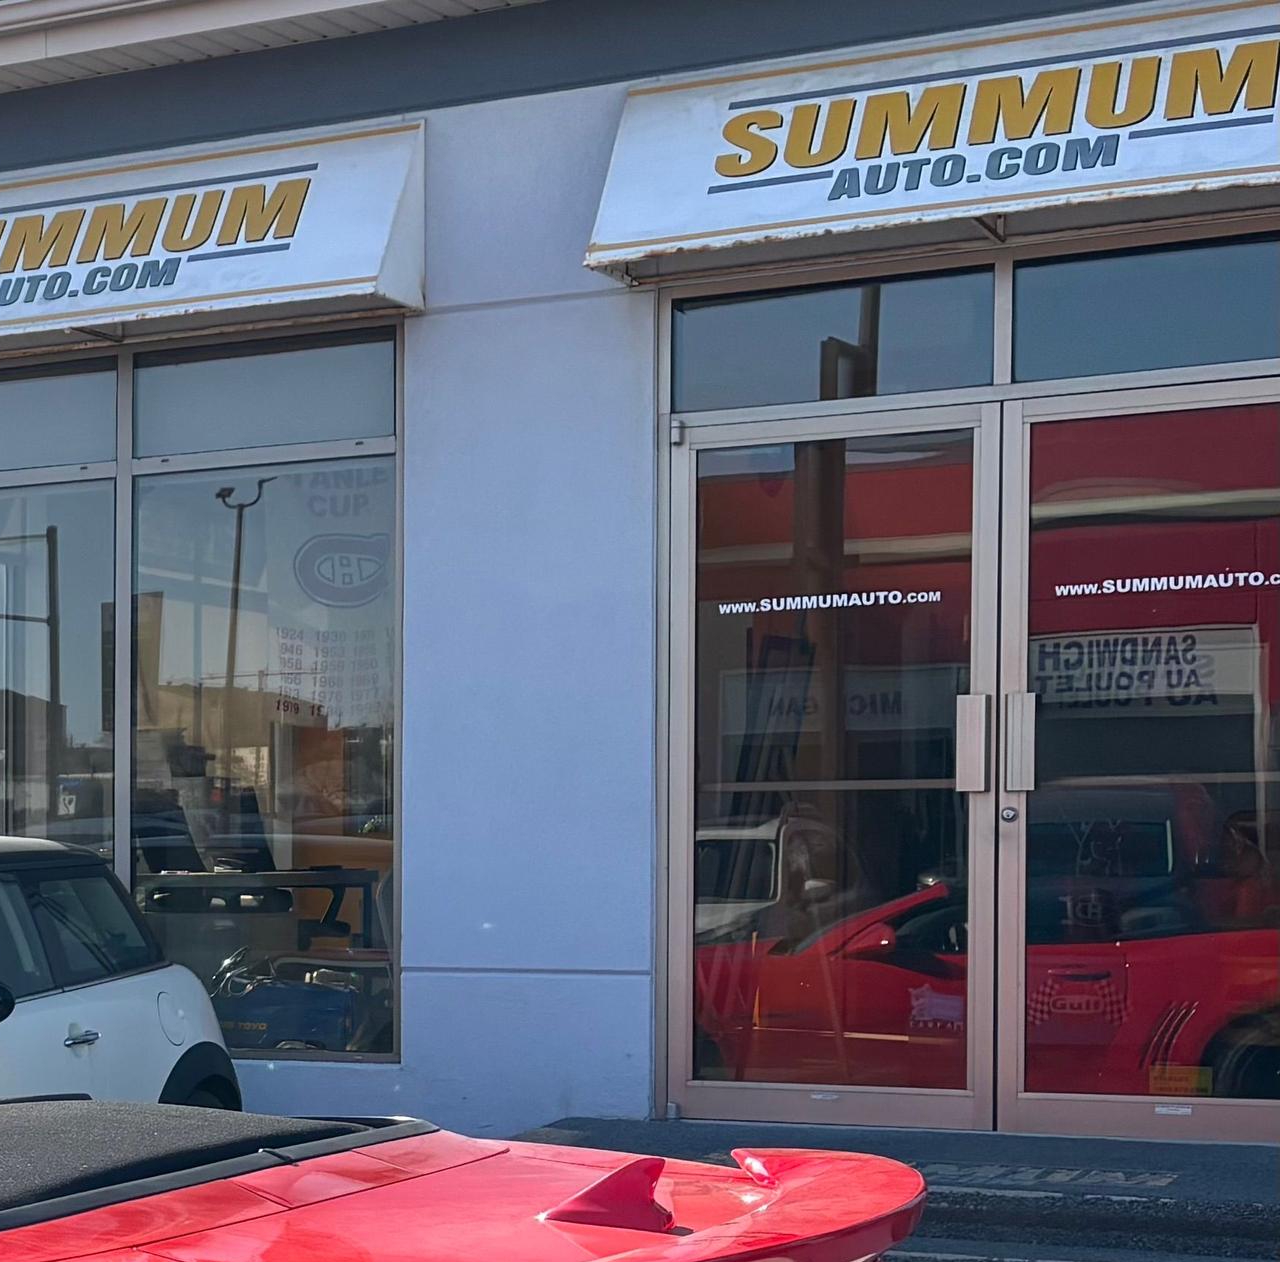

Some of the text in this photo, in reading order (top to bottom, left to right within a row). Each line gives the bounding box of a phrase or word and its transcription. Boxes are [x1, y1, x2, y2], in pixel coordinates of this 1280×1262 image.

[713, 39, 1280, 179] SUMMUM
[827, 133, 1121, 202] AUTO.COM
[306, 494, 370, 517] CUP
